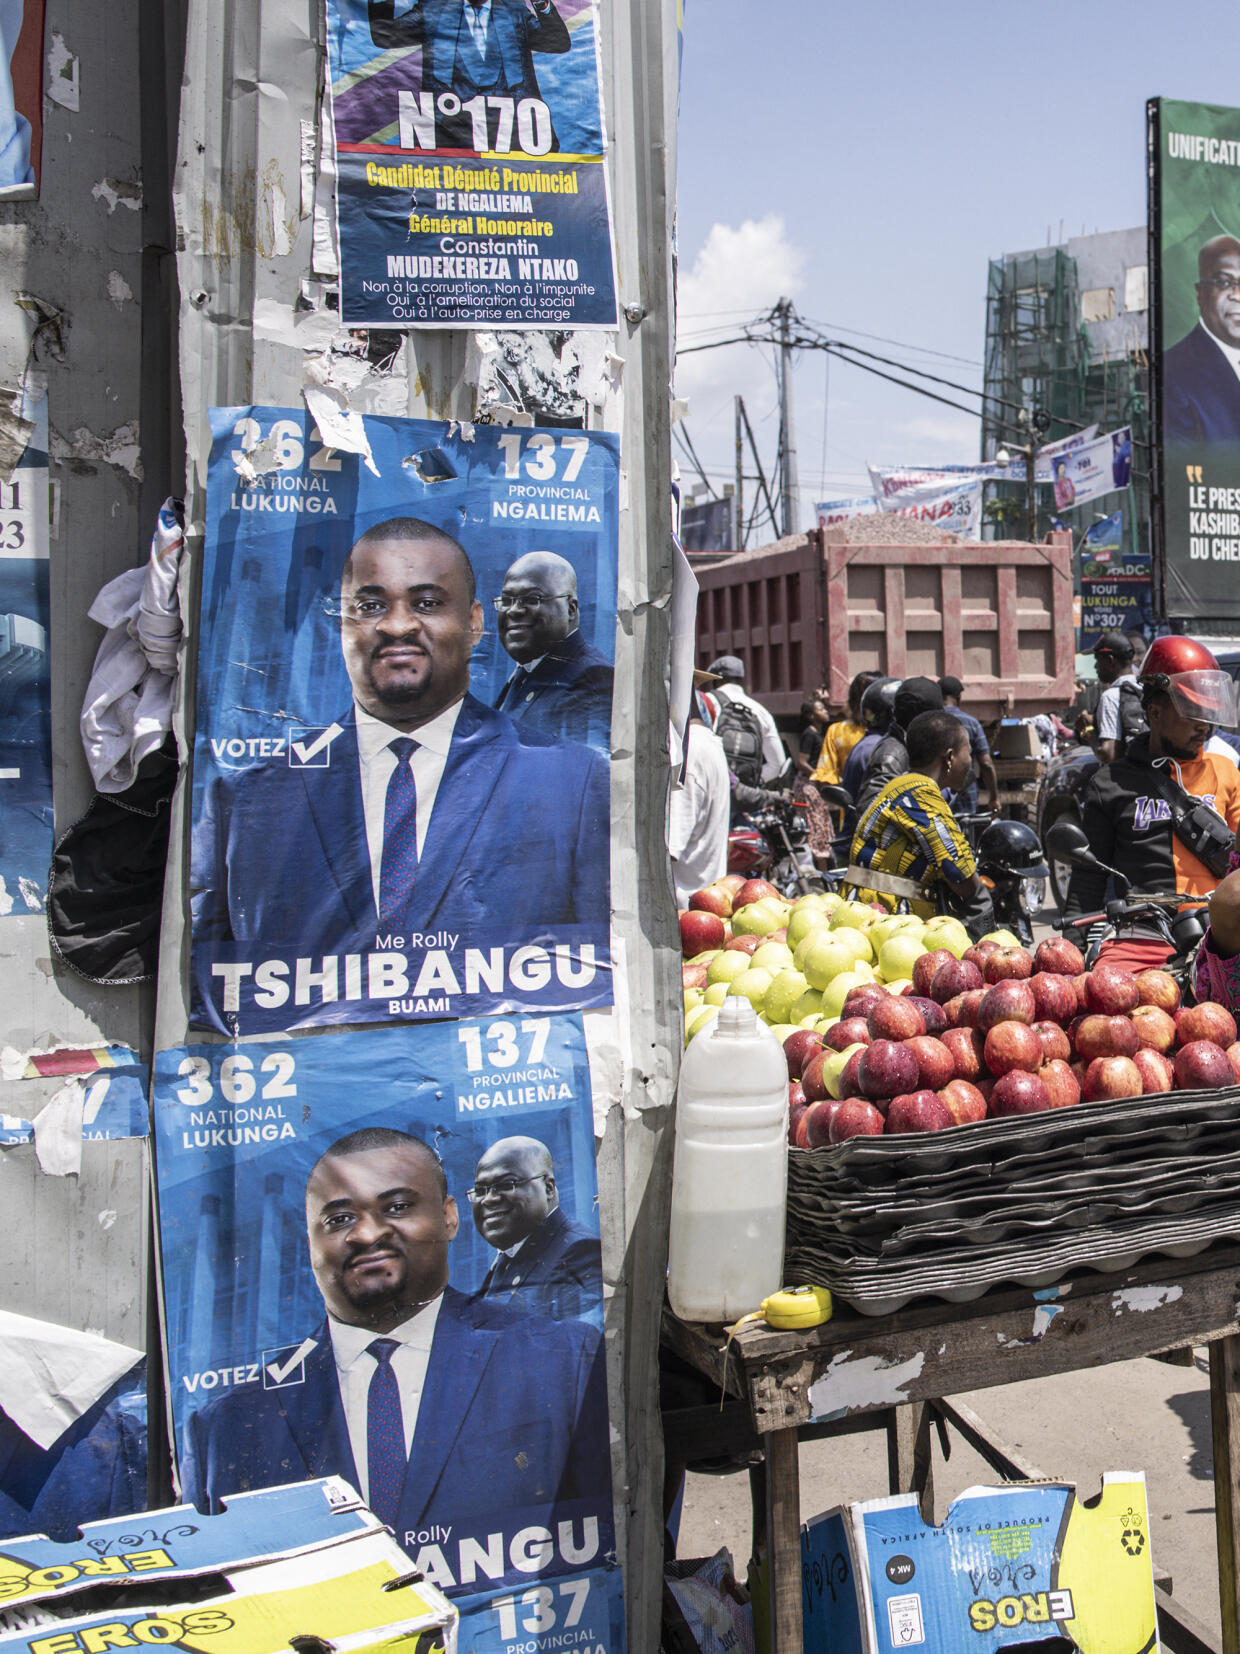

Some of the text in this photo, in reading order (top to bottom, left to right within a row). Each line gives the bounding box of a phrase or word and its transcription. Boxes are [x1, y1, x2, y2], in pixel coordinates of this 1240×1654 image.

[398, 90, 553, 156] N°170
[366, 162, 578, 194] Candidat Député Provincial
[436, 193, 533, 213] DE NGALIEMA
[409, 214, 553, 236] Général Honoraire
[440, 237, 538, 255] Constantin
[387, 255, 578, 281] MUDEKEREZA NTAKO
[363, 281, 389, 293] Non
[393, 281, 402, 293] à
[406, 281, 418, 293] la
[422, 282, 492, 296] corruption,
[495, 283, 521, 294] Non
[525, 282, 533, 294] à
[387, 293, 410, 305] Oui
[416, 293, 426, 305] à
[520, 294, 537, 306] du
[540, 295, 575, 307] social
[393, 306, 416, 318] Oui
[419, 306, 427, 318] à
[505, 310, 522, 319] en
[526, 306, 571, 322] charge
[499, 433, 590, 482] 137
[0, 481, 24, 510] 1
[239, 476, 330, 493] NATIONAL
[508, 485, 591, 501] PROVINCIAL
[231, 494, 338, 515] LUKUNGA
[1190, 486, 1206, 509] LE
[493, 501, 601, 523] NGALIEMA
[0, 520, 25, 549] 3
[1190, 538, 1209, 560] DU
[1091, 585, 1118, 595] TOUT
[1081, 596, 1137, 607] LUKUNGA
[1084, 614, 1126, 627] N°307
[211, 738, 286, 758] VOTEZ
[1132, 794, 1218, 831] LAKS
[376, 932, 459, 951] Me Rolly
[211, 944, 597, 1012] TSHIBANGU
[389, 998, 450, 1015] BUAMI
[458, 1018, 552, 1072] 137
[177, 1052, 298, 1106] 362
[473, 1067, 560, 1088] PROVINCIAL
[458, 1082, 573, 1112] NGALIEMA
[190, 1104, 286, 1125] NATIONAL
[182, 1121, 297, 1149] LUKUNGA
[183, 1363, 260, 1393] VOTEZ
[978, 1522, 991, 1531] OF
[998, 1516, 1050, 1528] PRODUCE
[405, 1525, 453, 1547] Rolly
[881, 1532, 926, 1544] AFRICA
[889, 1564, 911, 1575] MK 4
[492, 1577, 591, 1642] 137
[969, 1588, 1075, 1633] EROS
[28, 1610, 235, 1654] EROS
[506, 1629, 596, 1654] PROVINCIAL
